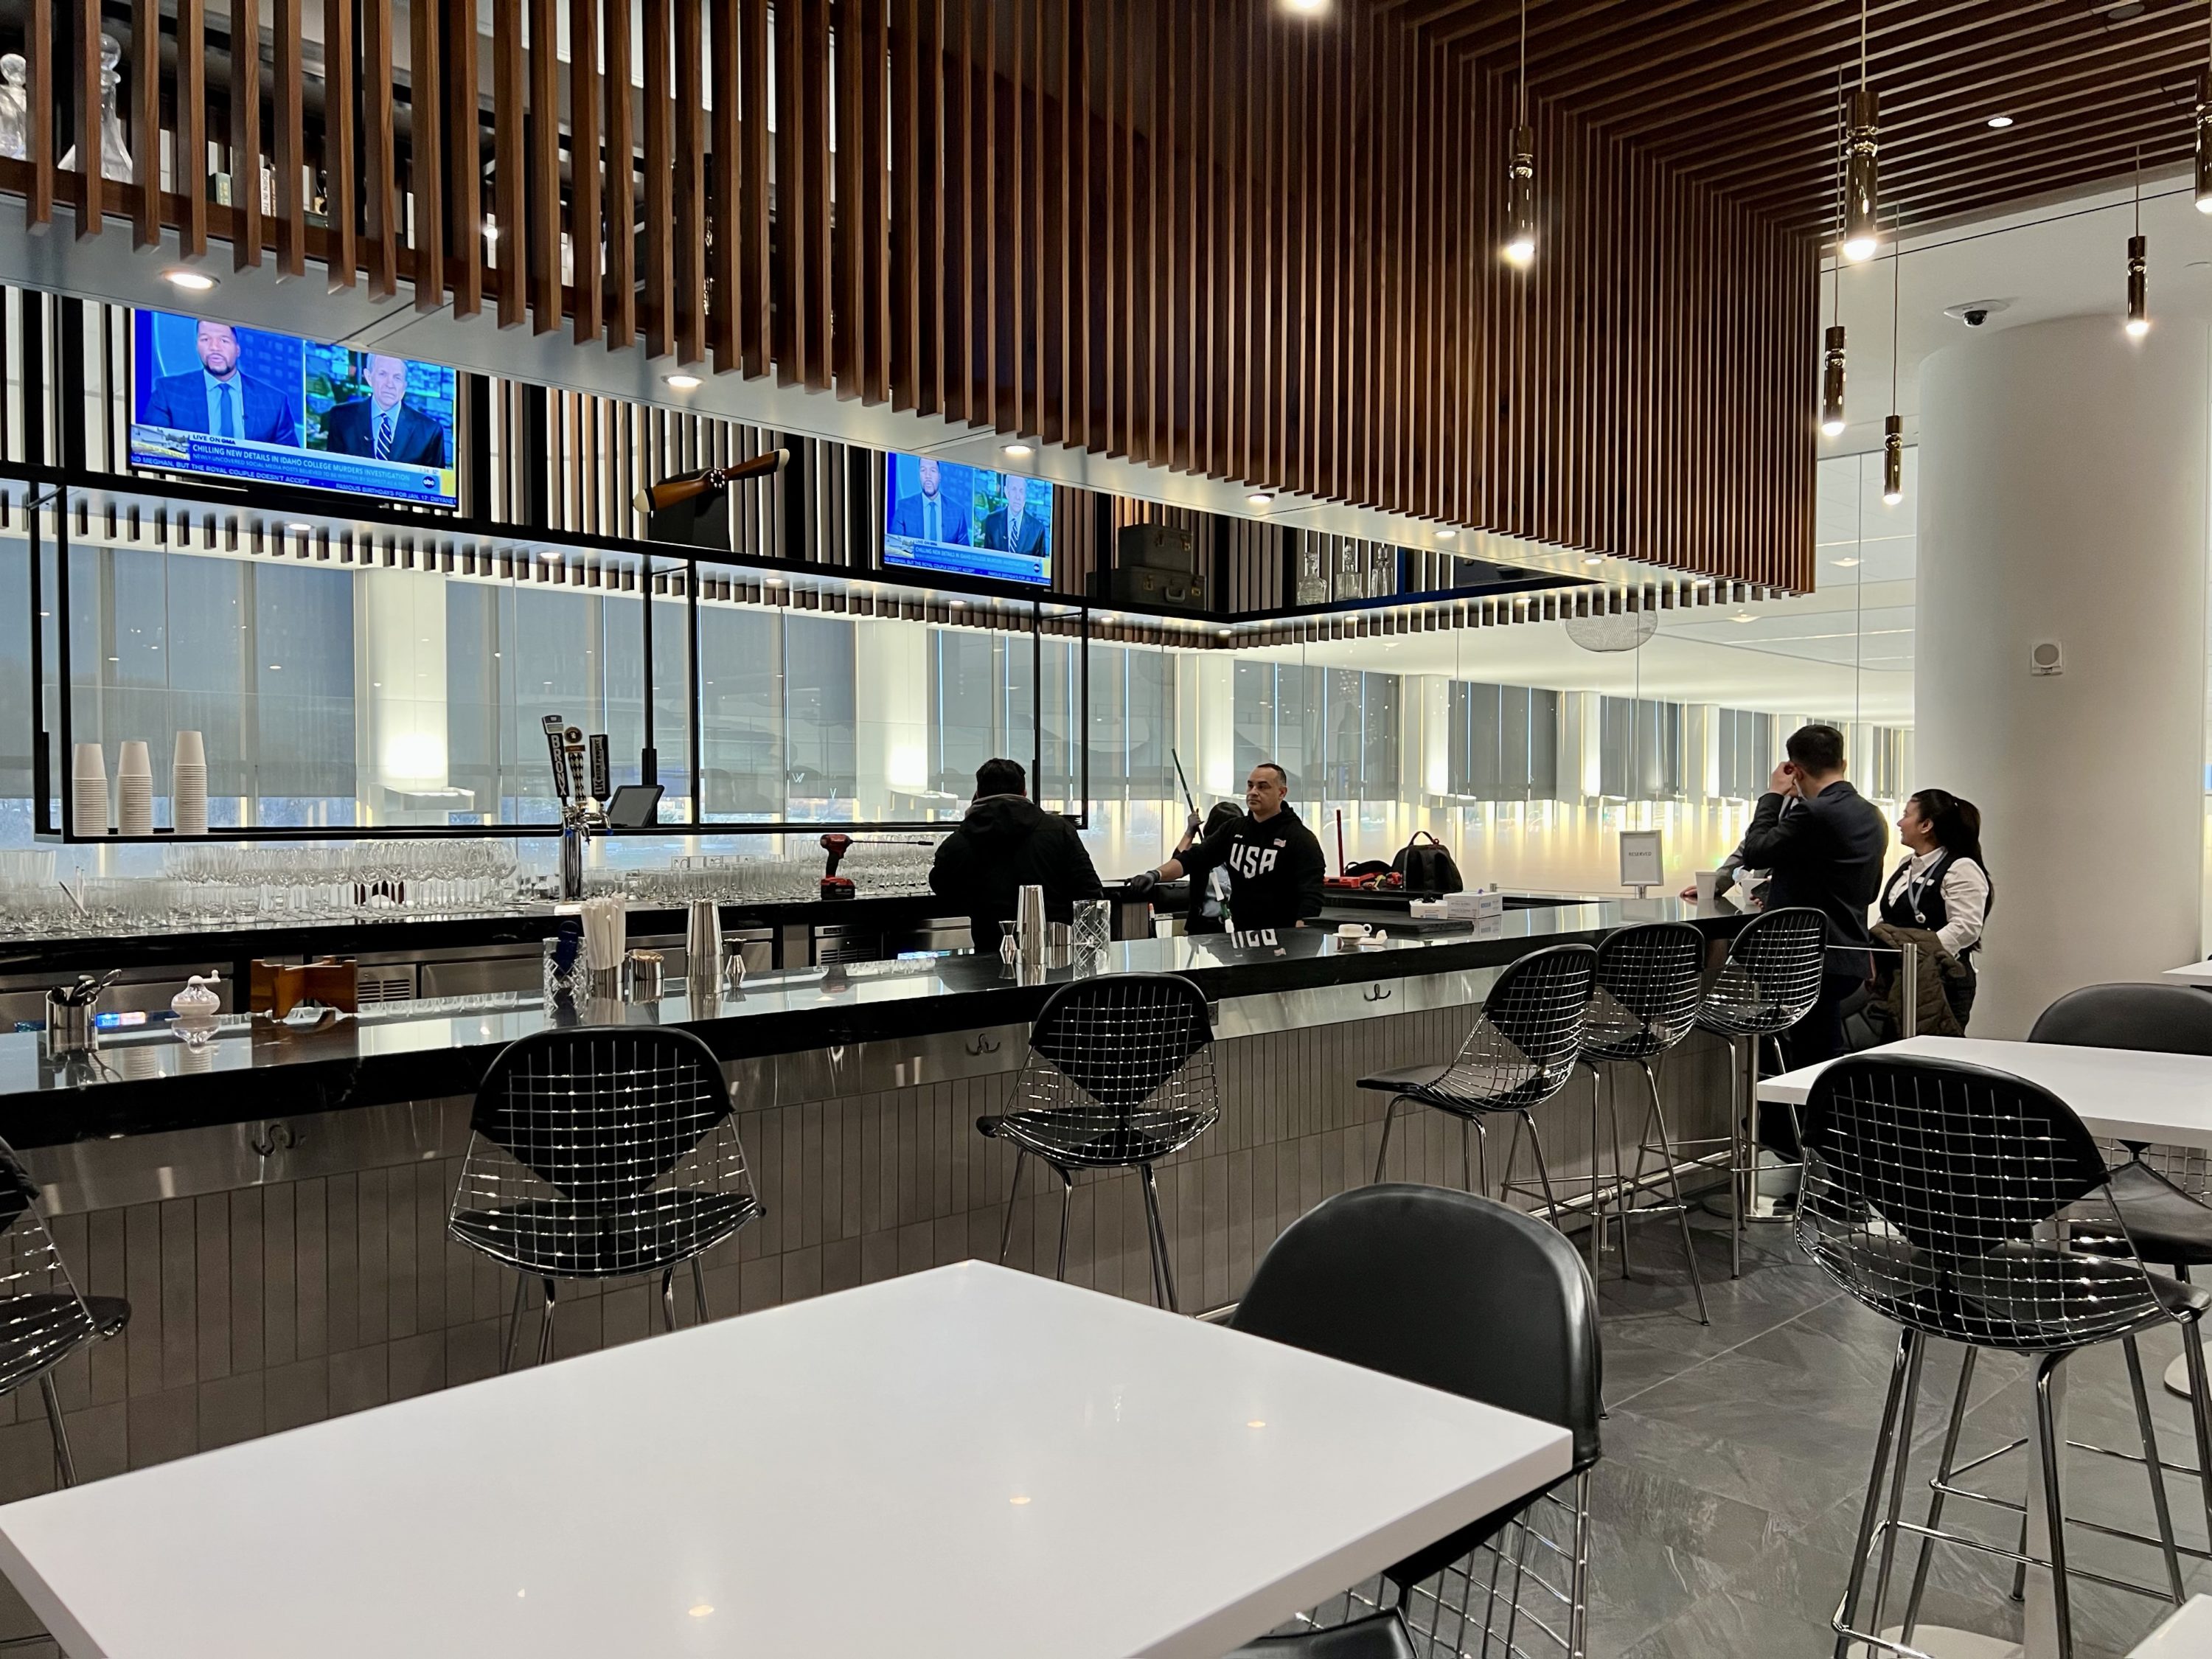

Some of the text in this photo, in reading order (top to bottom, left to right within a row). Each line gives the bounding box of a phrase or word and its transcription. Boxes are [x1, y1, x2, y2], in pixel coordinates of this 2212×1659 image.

[192, 444, 225, 455] CHILLING
[226, 449, 243, 457] NEW
[243, 451, 270, 462] DETAILS
[280, 456, 302, 466] IDAHO
[303, 460, 332, 470] COLLEGE
[333, 464, 363, 474] MURDERS
[364, 469, 410, 481] INVESTIGATION
[206, 465, 227, 474] ROYAL
[229, 468, 254, 478] COUPLE
[285, 476, 310, 484] ACCEPT
[335, 483, 361, 492] FAMOUS
[551, 734, 567, 796] BRONX
[595, 780, 604, 793] LIC
[1229, 843, 1278, 879] USA
